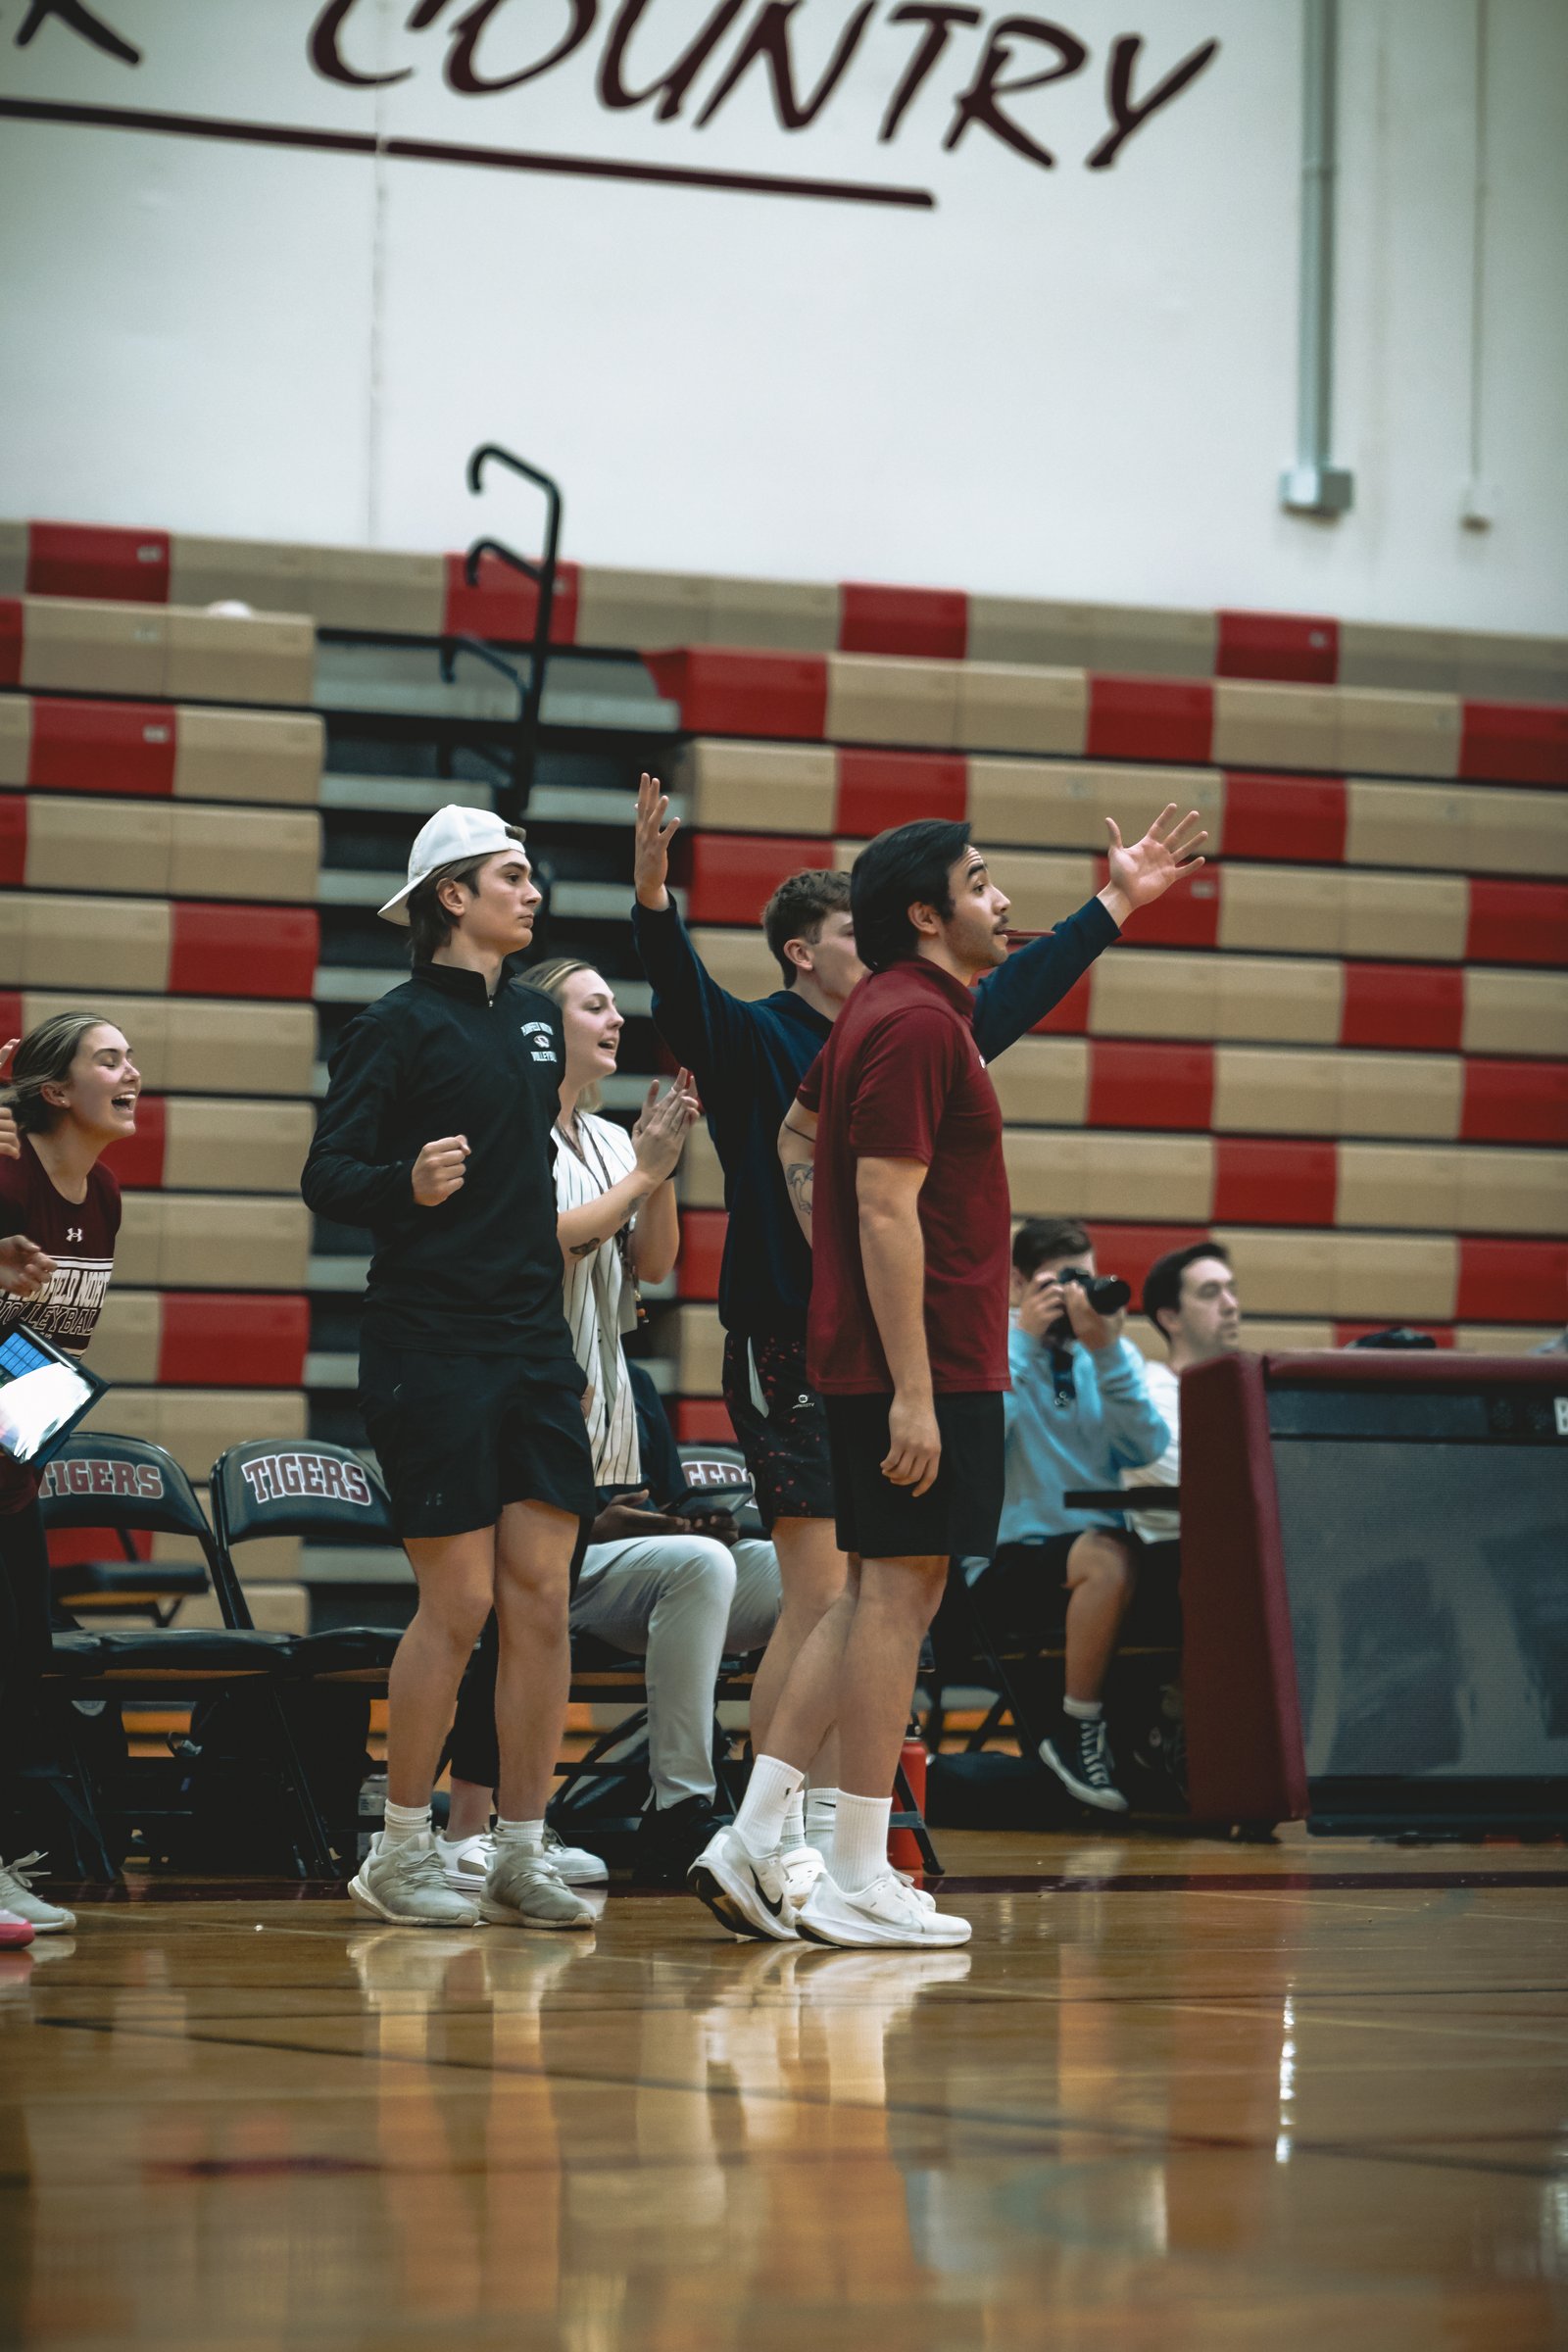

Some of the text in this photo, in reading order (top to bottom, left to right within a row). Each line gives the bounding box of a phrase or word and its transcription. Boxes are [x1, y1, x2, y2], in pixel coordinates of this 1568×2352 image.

[306, 0, 1219, 169] COUNTRY
[0, 1300, 98, 1336] VOLLEYBAL
[241, 1453, 371, 1506] TIGERS
